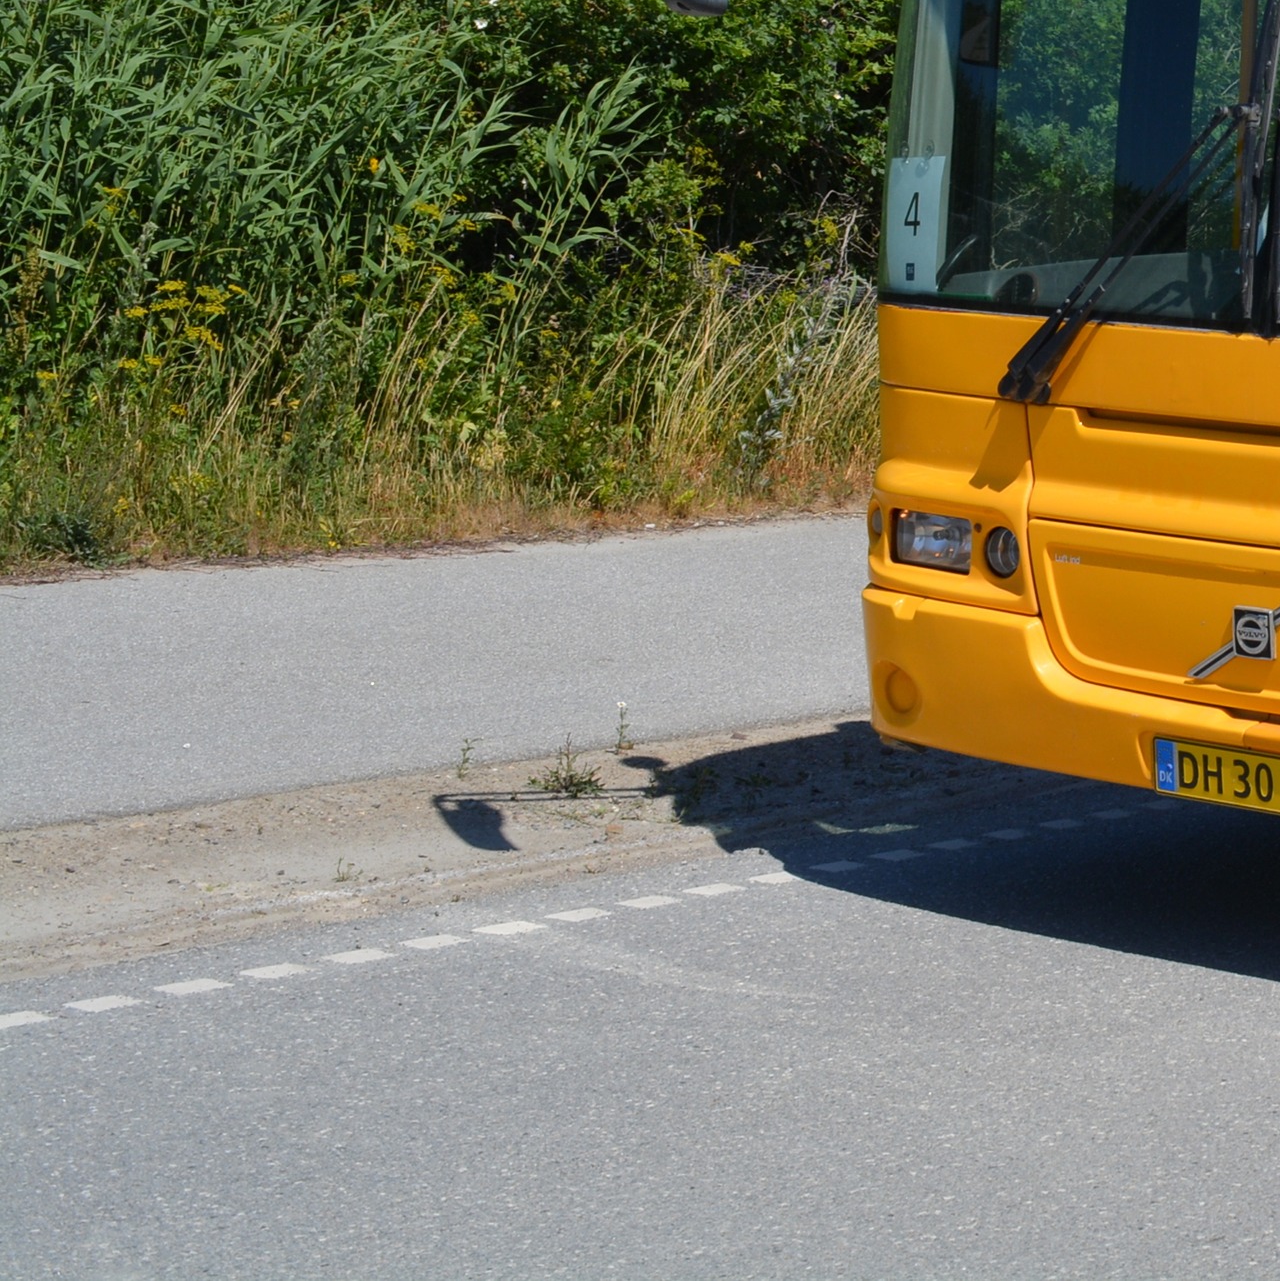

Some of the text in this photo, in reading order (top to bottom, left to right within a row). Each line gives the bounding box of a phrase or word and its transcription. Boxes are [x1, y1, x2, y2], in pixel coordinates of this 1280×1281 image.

[903, 191, 921, 237] 4
[1237, 629, 1267, 639] VOLVO
[1159, 770, 1173, 784] DK
[1178, 750, 1223, 795] DH
[1233, 759, 1274, 803] 30
